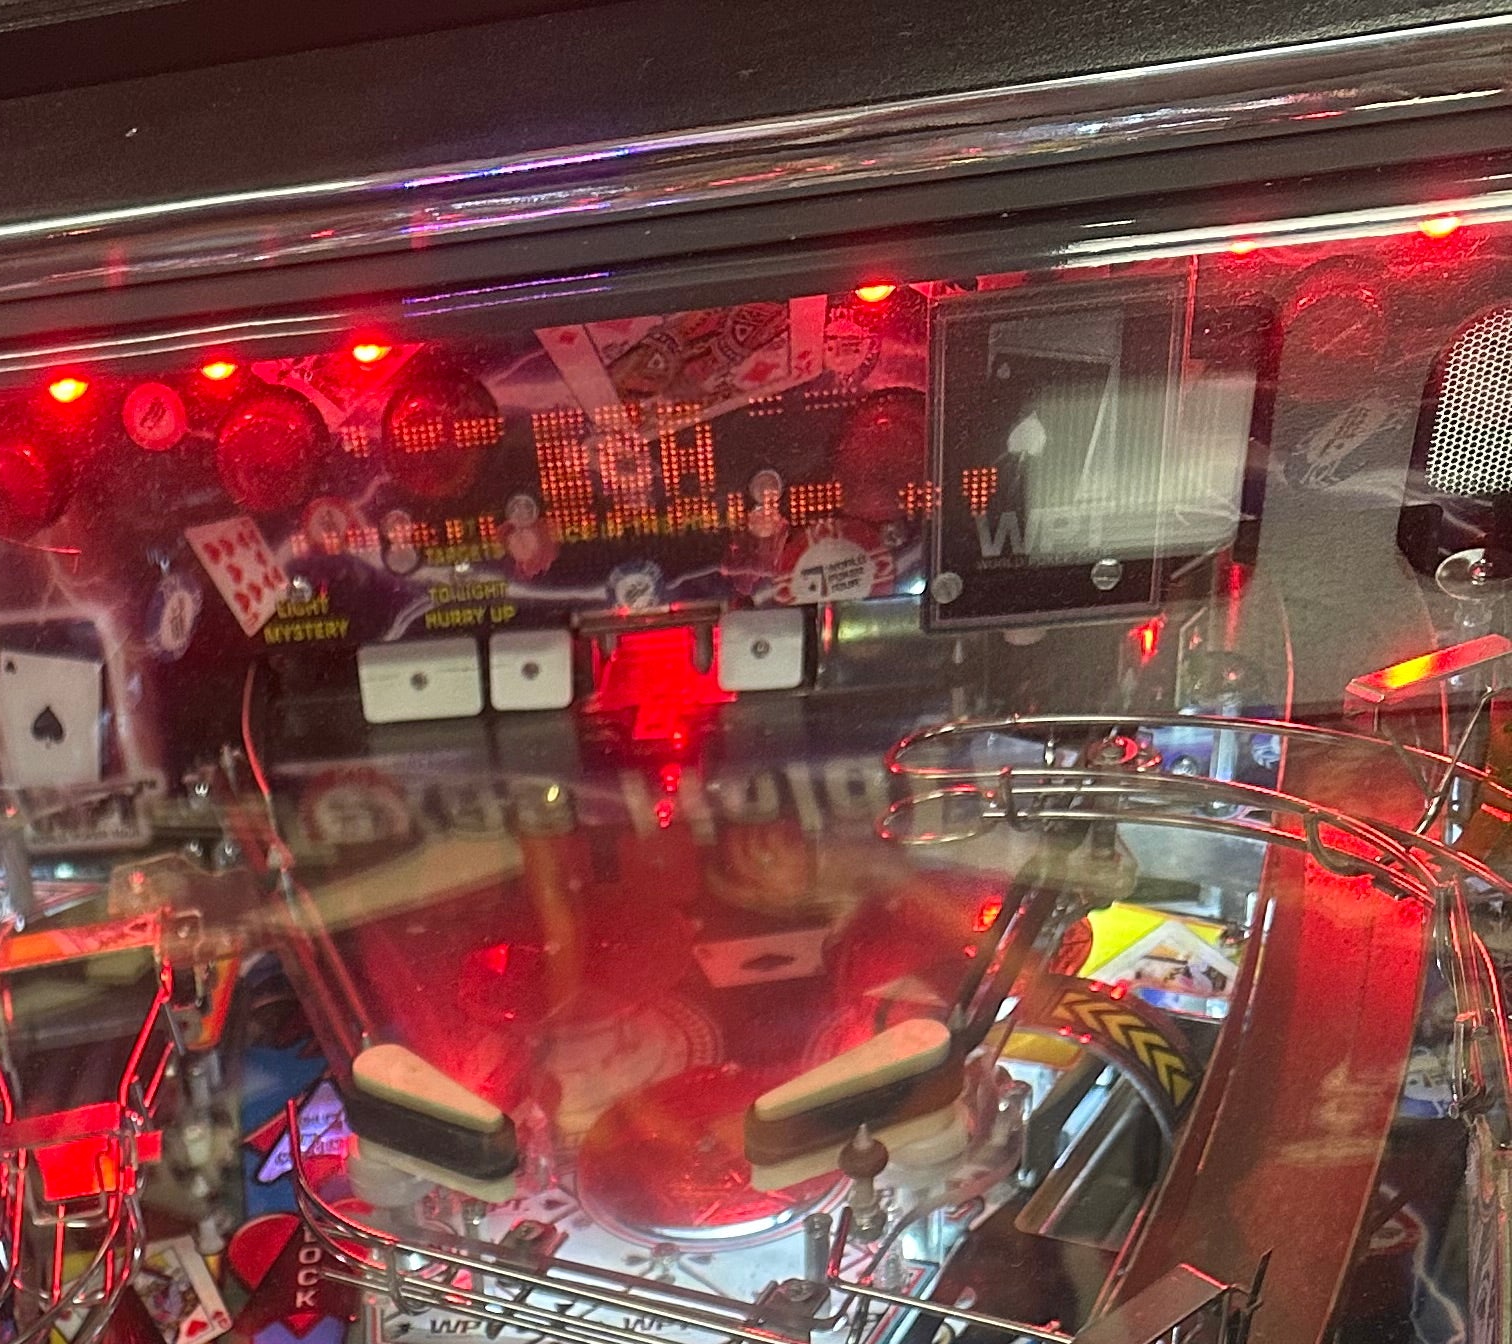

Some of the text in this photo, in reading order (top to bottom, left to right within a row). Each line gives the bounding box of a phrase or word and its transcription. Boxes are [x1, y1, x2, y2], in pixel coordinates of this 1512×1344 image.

[425, 602, 517, 629] HURRY UP
[264, 616, 350, 644] MYSTERY
